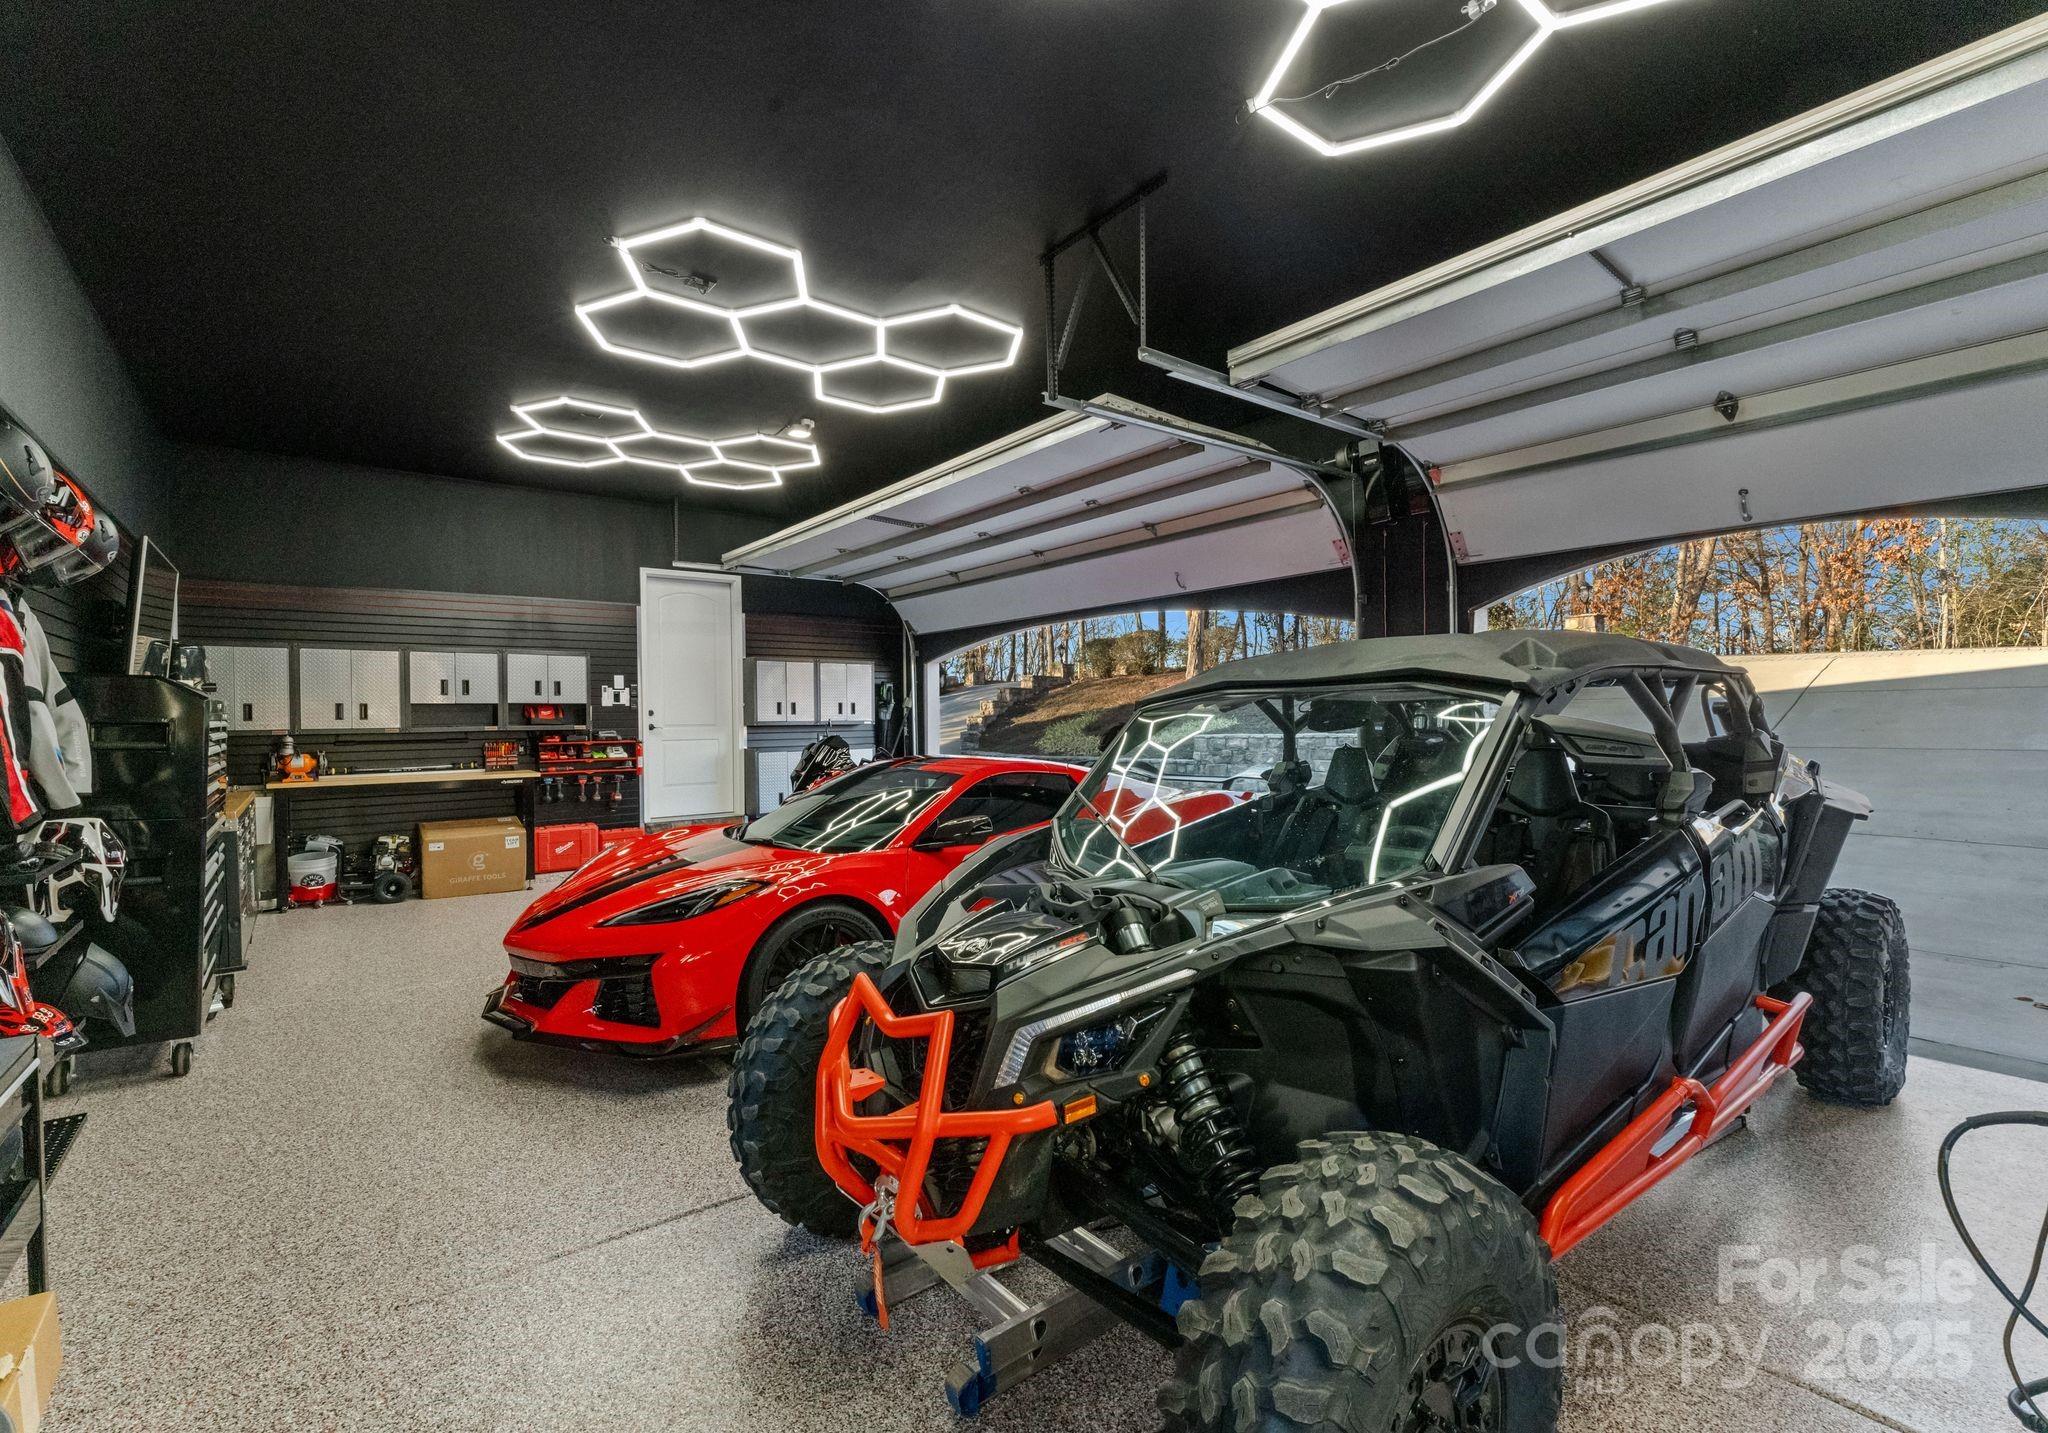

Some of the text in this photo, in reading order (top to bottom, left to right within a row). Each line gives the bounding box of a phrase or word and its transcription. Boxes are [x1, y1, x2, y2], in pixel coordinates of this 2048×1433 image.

[449, 872, 507, 884] GIRAFFE TOOLS
[1004, 944, 1057, 972] TURBO
